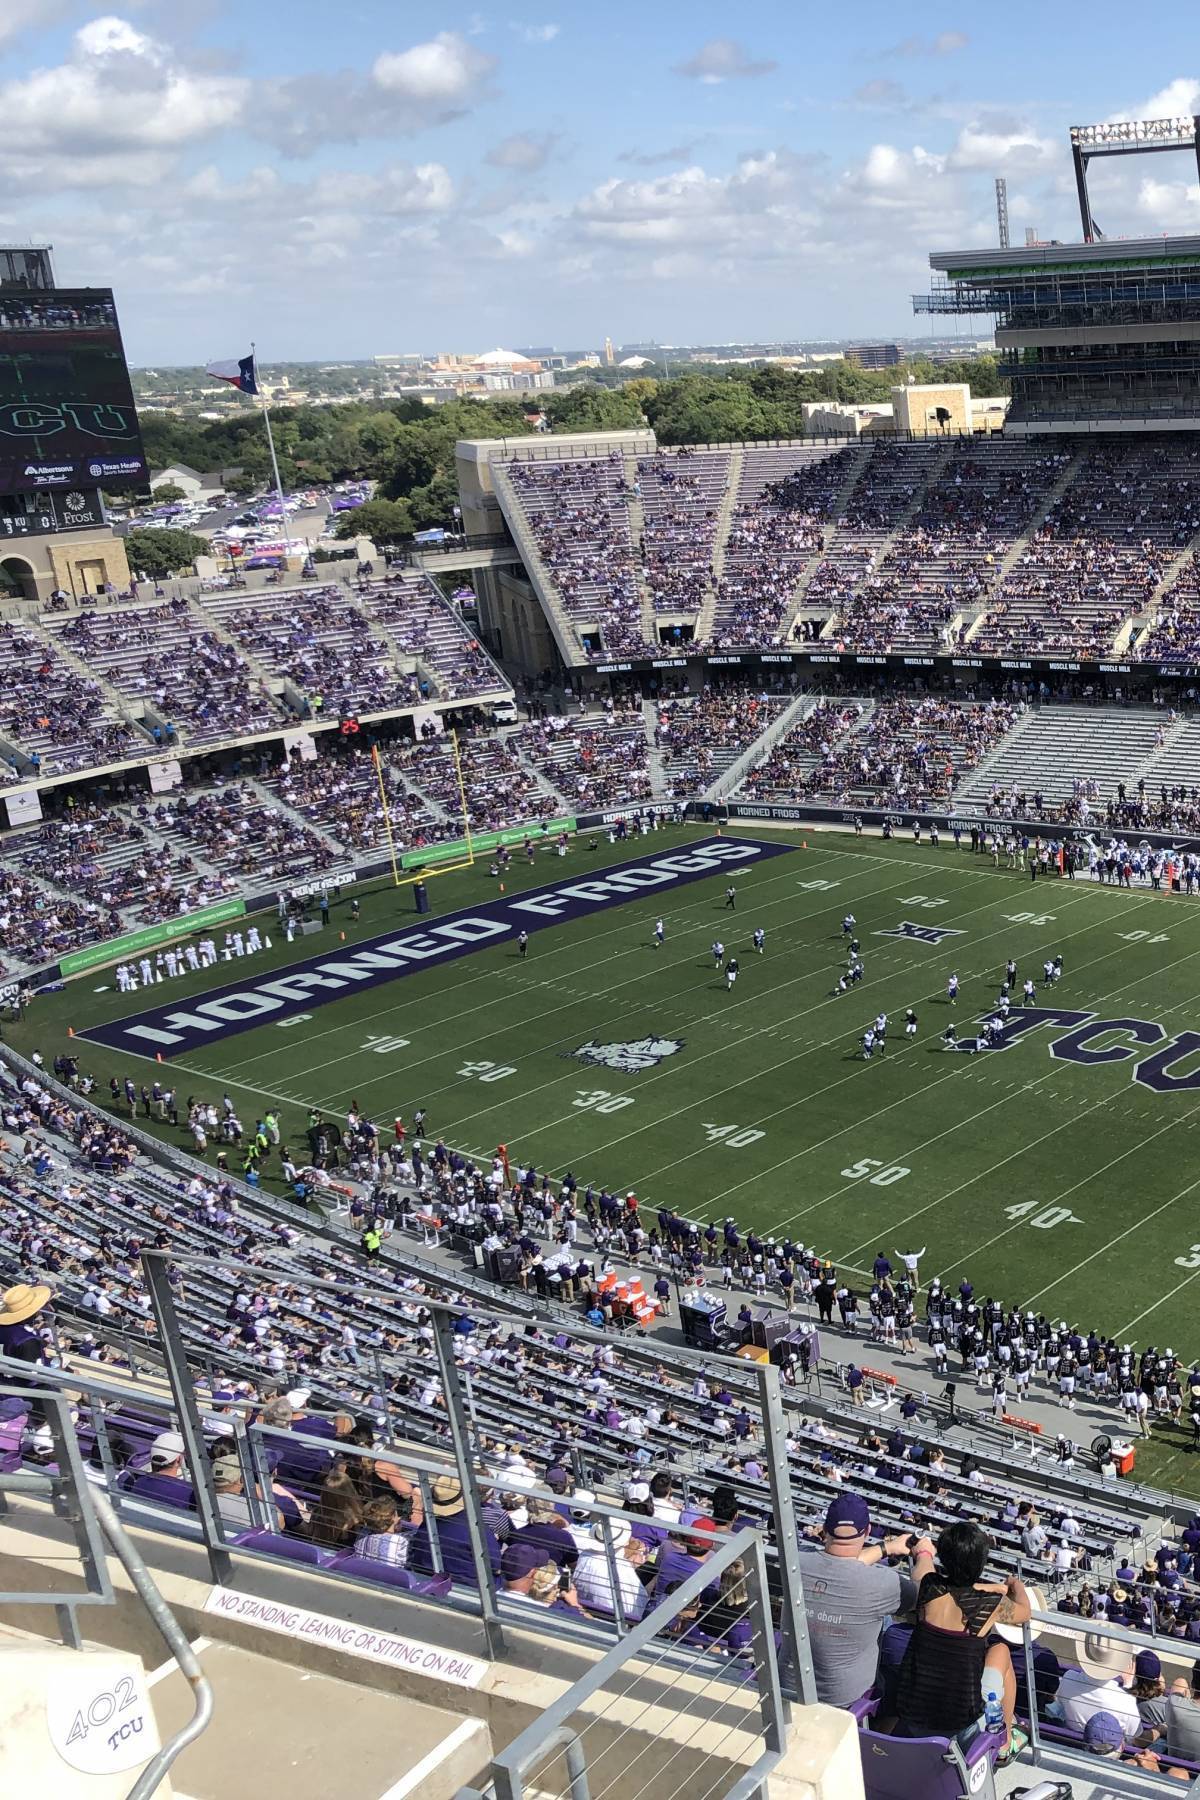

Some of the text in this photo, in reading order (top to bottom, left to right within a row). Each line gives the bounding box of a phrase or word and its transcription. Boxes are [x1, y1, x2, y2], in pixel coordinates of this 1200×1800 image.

[37, 466, 73, 475] Albertsons
[14, 517, 26, 526] KU
[41, 516, 49, 528] 0
[63, 511, 95, 525] Frost
[7, 524, 13, 534] 3
[652, 659, 687, 668] MUSCLE MILK
[904, 657, 922, 665] MUSCLE
[1068, 663, 1080, 671] MILK
[1099, 664, 1131, 673] MUSCLE MILK
[342, 719, 359, 735] 25
[602, 808, 641, 824] HORNED
[736, 806, 800, 819] HORNED FROGS
[947, 819, 1013, 835] HORNED FROGS
[802, 879, 841, 891] 10
[901, 894, 949, 908] 20
[1006, 911, 1058, 925] 30
[885, 923, 962, 944] XII
[1123, 929, 1171, 944] 40
[123, 841, 763, 1046] HORNED FROGS
[359, 1035, 411, 1054] 10
[455, 1061, 518, 1082] 20
[571, 1090, 636, 1113] 30
[705, 1123, 767, 1148] 40
[840, 1158, 911, 1186] 50
[1002, 1200, 1073, 1229] 40
[1048, 1346, 1058, 1354] 70
[817, 1611, 842, 1624] about
[216, 1594, 474, 1680] NO STANDING, LEANING OR SITTING ON RAIL
[65, 1676, 138, 1745] 402
[107, 1716, 143, 1751] TCU
[971, 1762, 986, 1785] TCU
